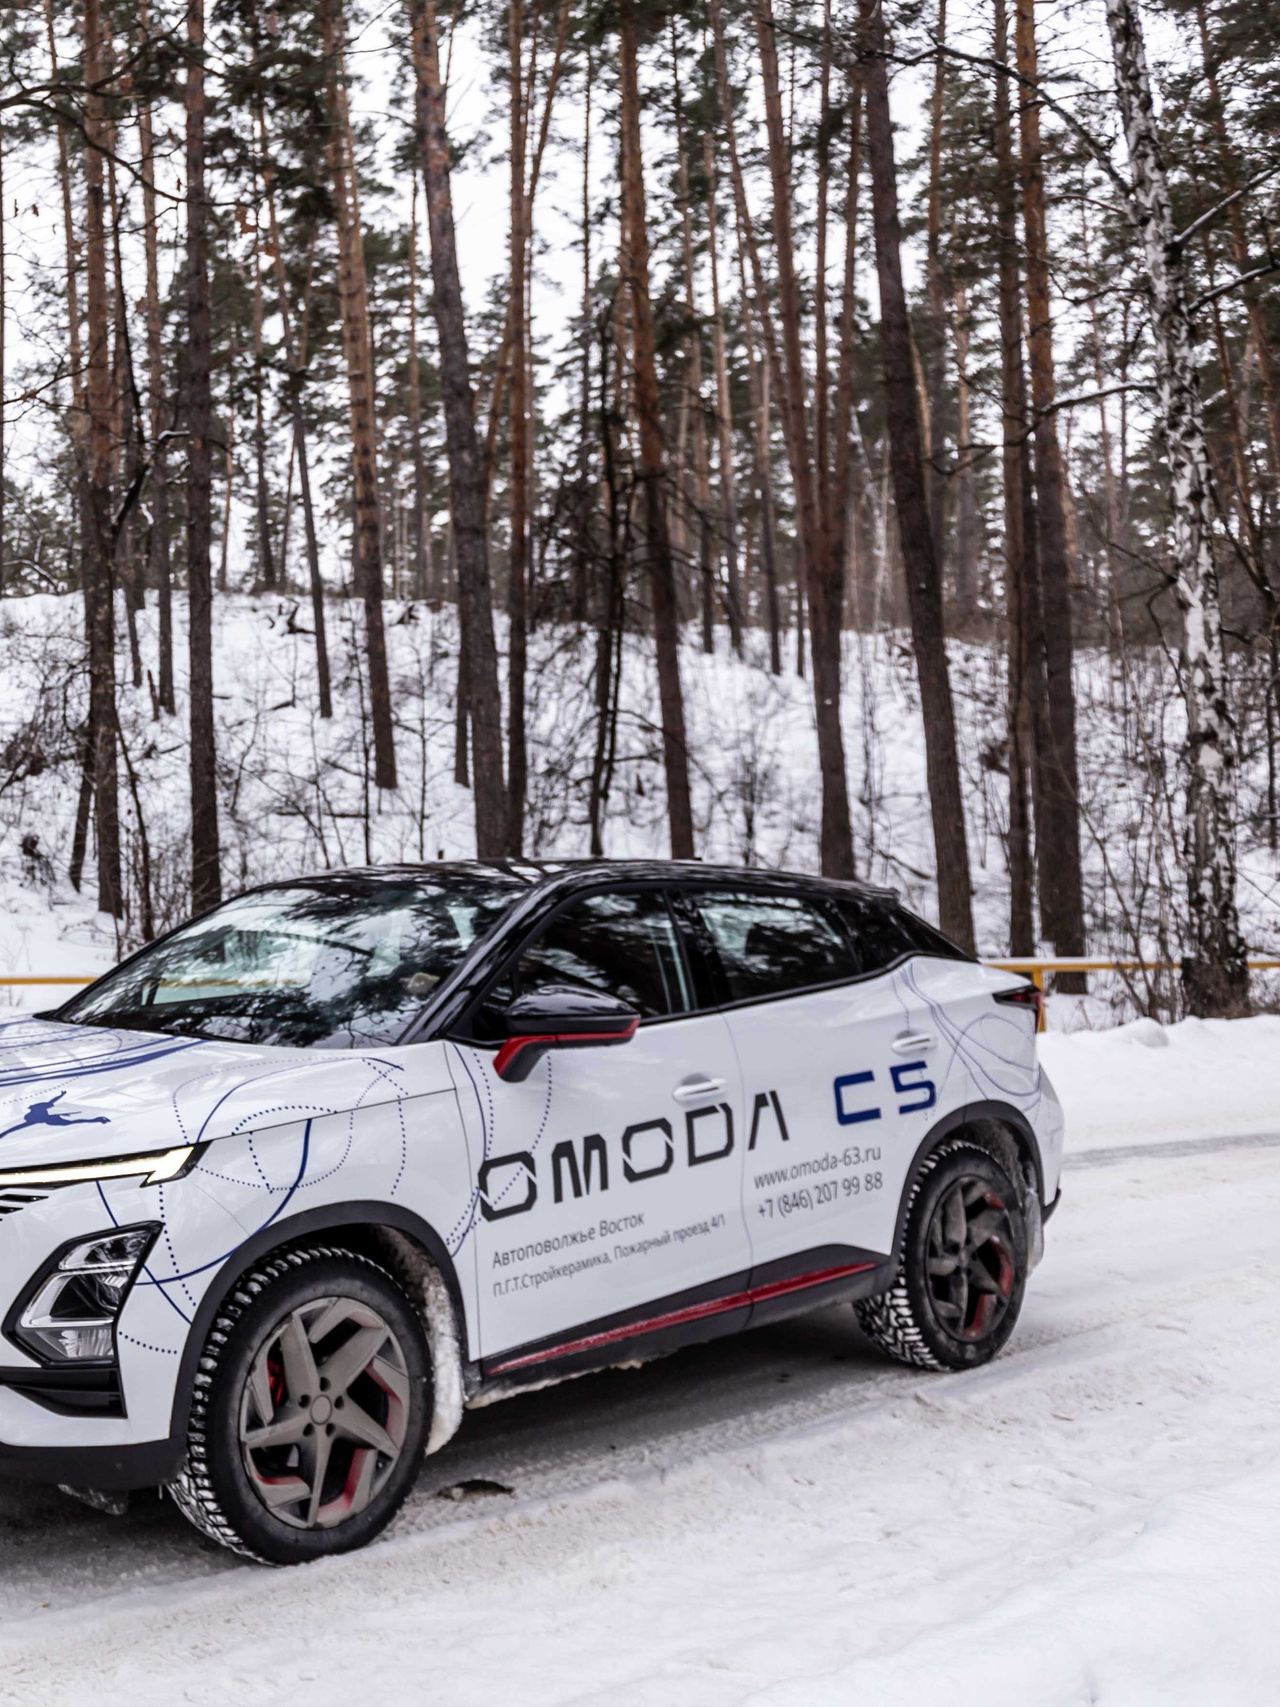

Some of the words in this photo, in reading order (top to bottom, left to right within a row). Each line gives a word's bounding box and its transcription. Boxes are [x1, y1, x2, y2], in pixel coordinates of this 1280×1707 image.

[478, 1089, 790, 1222] OMODA
[833, 1060, 937, 1126] C5
[753, 1146, 882, 1190] www.omoda-63.ru
[758, 1198, 774, 1219] +7
[777, 1188, 814, 1219] (846)
[813, 1180, 839, 1204] 207
[842, 1175, 861, 1198] 99
[864, 1171, 884, 1193] 88
[492, 1227, 596, 1270] Автоповолжье
[599, 1212, 645, 1238] Восток
[614, 1229, 672, 1261] Пожарный
[673, 1221, 711, 1244] проезд
